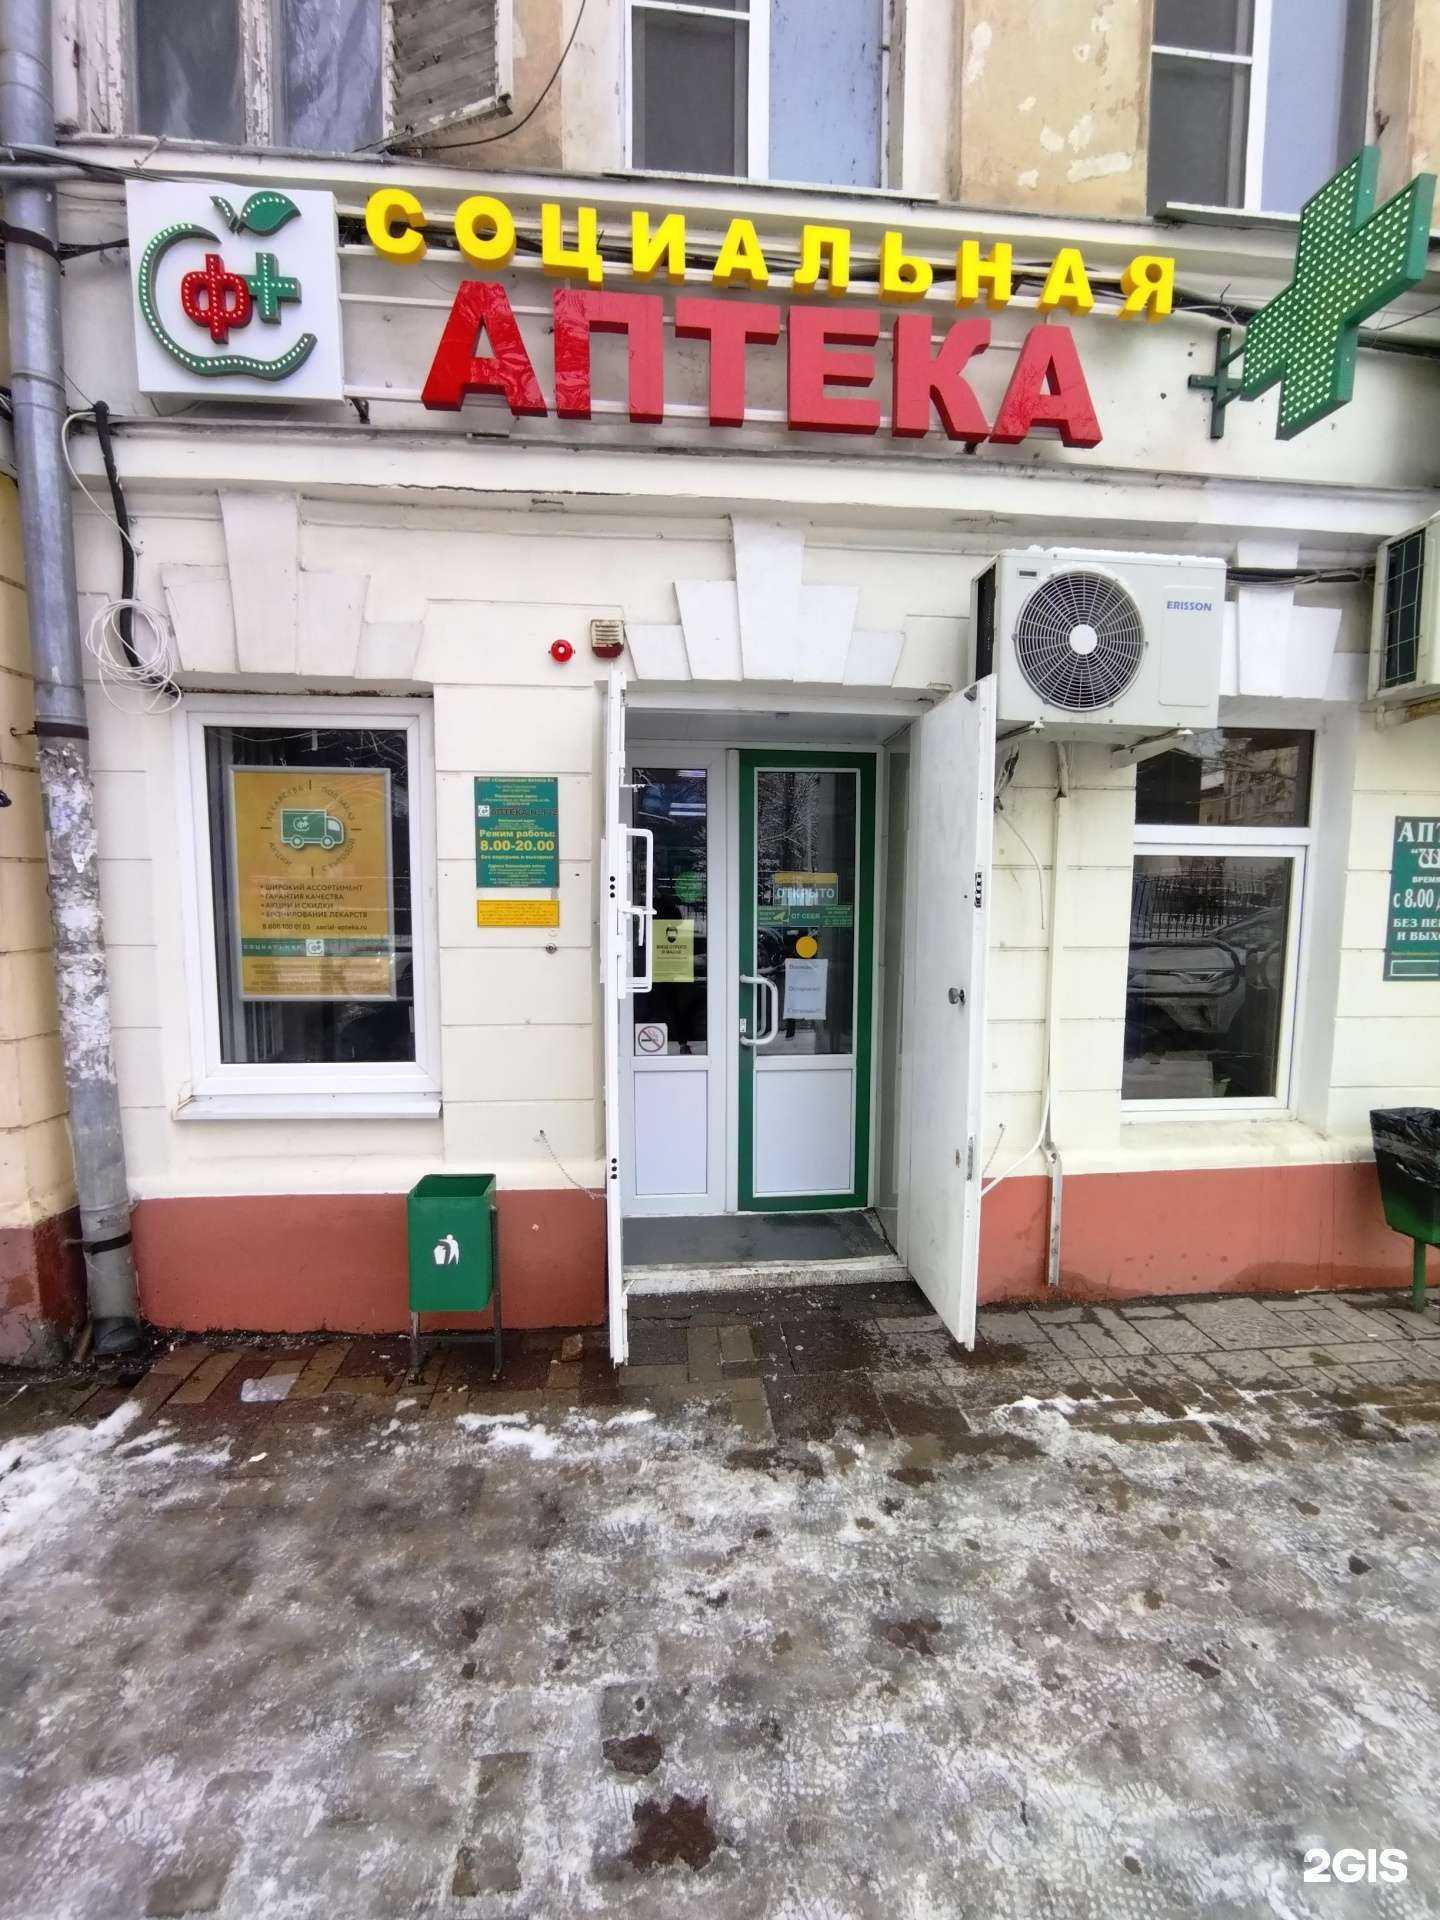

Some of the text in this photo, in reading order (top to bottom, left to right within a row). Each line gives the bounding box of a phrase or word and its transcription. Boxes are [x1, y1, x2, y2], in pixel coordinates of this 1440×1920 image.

[365, 188, 1176, 324] СОЦИАЛЬНАЯ
[420, 281, 1104, 448] АПТЕКА
[1166, 600, 1213, 612] ERISSON
[479, 829, 514, 838] Режим
[1397, 821, 1440, 843] АП
[480, 840, 555, 851] 8.00-20.00
[776, 887, 835, 899] ОТКРЫТО
[1404, 888, 1435, 909] 8.00
[1393, 918, 1418, 928] БЕЗ
